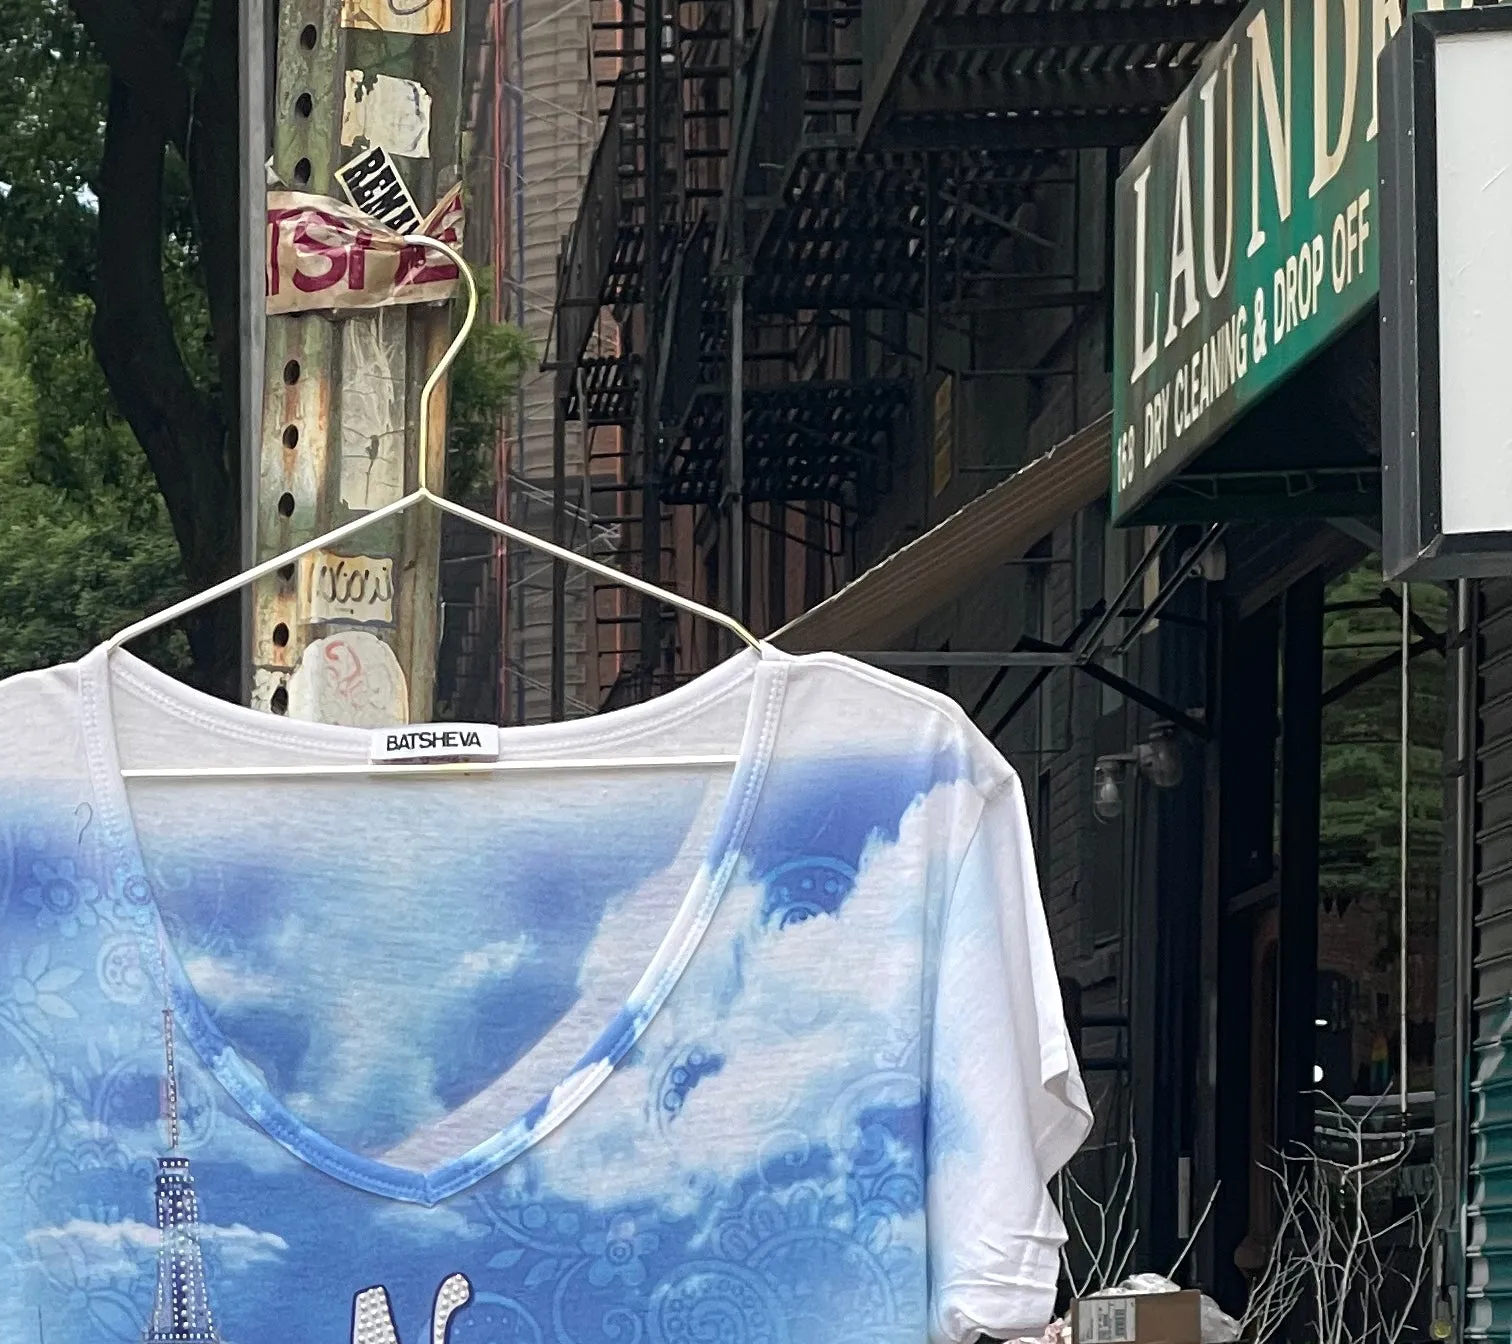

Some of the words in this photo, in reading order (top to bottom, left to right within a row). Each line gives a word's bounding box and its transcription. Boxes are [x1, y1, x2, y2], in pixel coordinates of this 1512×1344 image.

[1144, 382, 1170, 469] DRY
[1174, 305, 1248, 437] CLEANING
[1253, 287, 1267, 364] &
[1274, 234, 1324, 345] DROP
[1332, 188, 1370, 294] OFF
[386, 731, 482, 751] BATSHEVA
